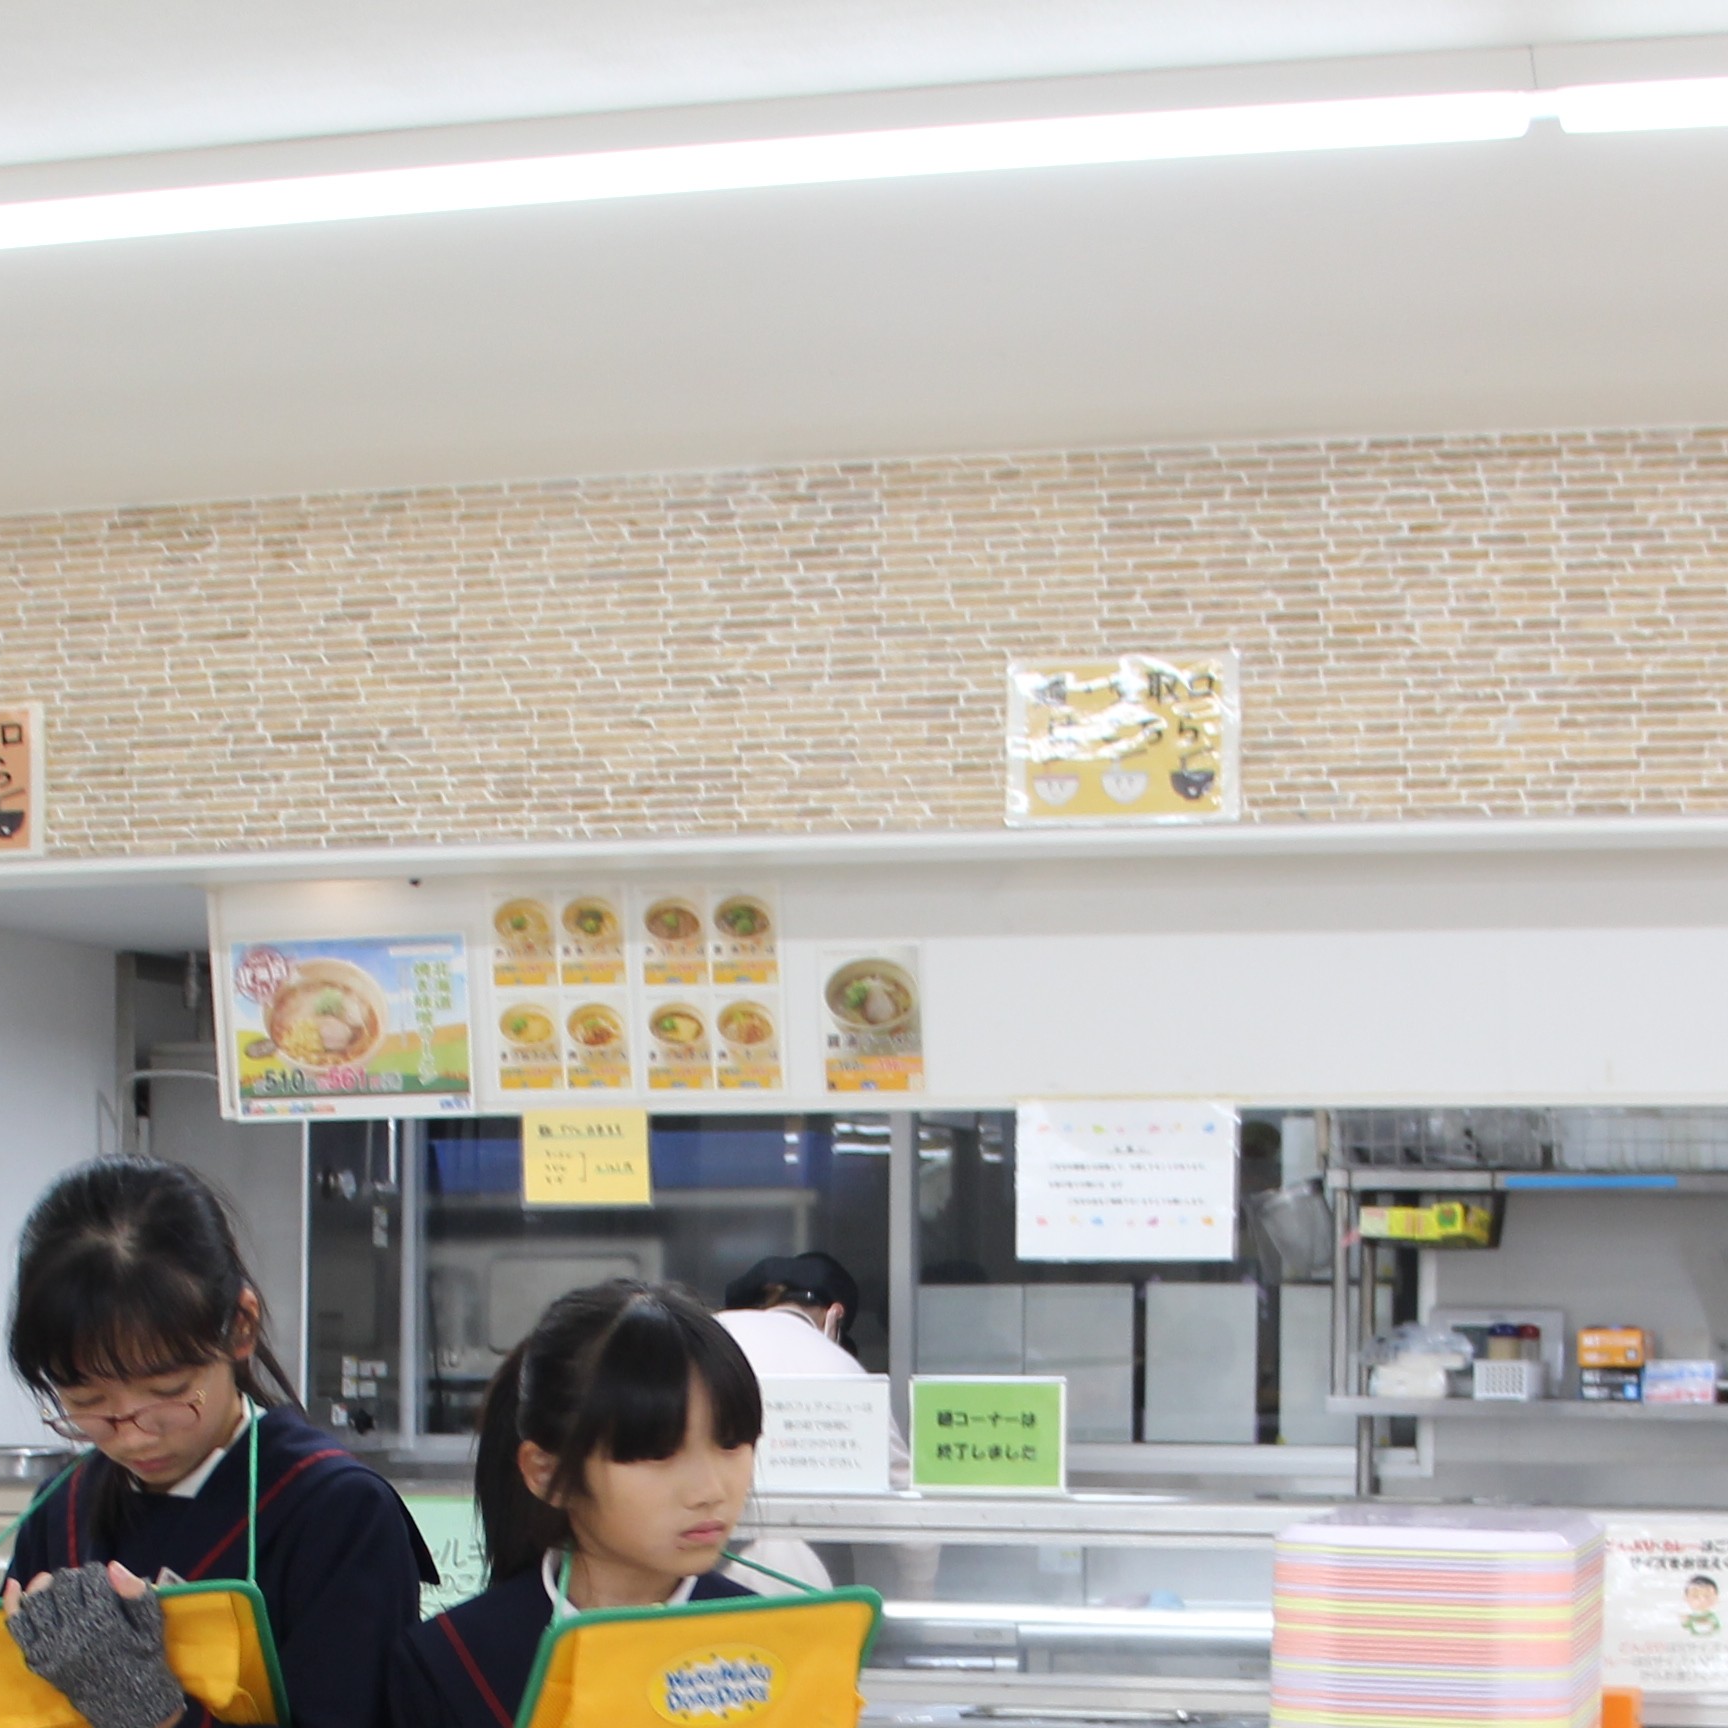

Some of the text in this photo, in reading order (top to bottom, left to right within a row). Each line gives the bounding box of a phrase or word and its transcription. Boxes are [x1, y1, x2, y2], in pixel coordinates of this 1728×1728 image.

[265, 1068, 305, 1091] 510
[936, 1442, 1037, 1461] 終了しました
